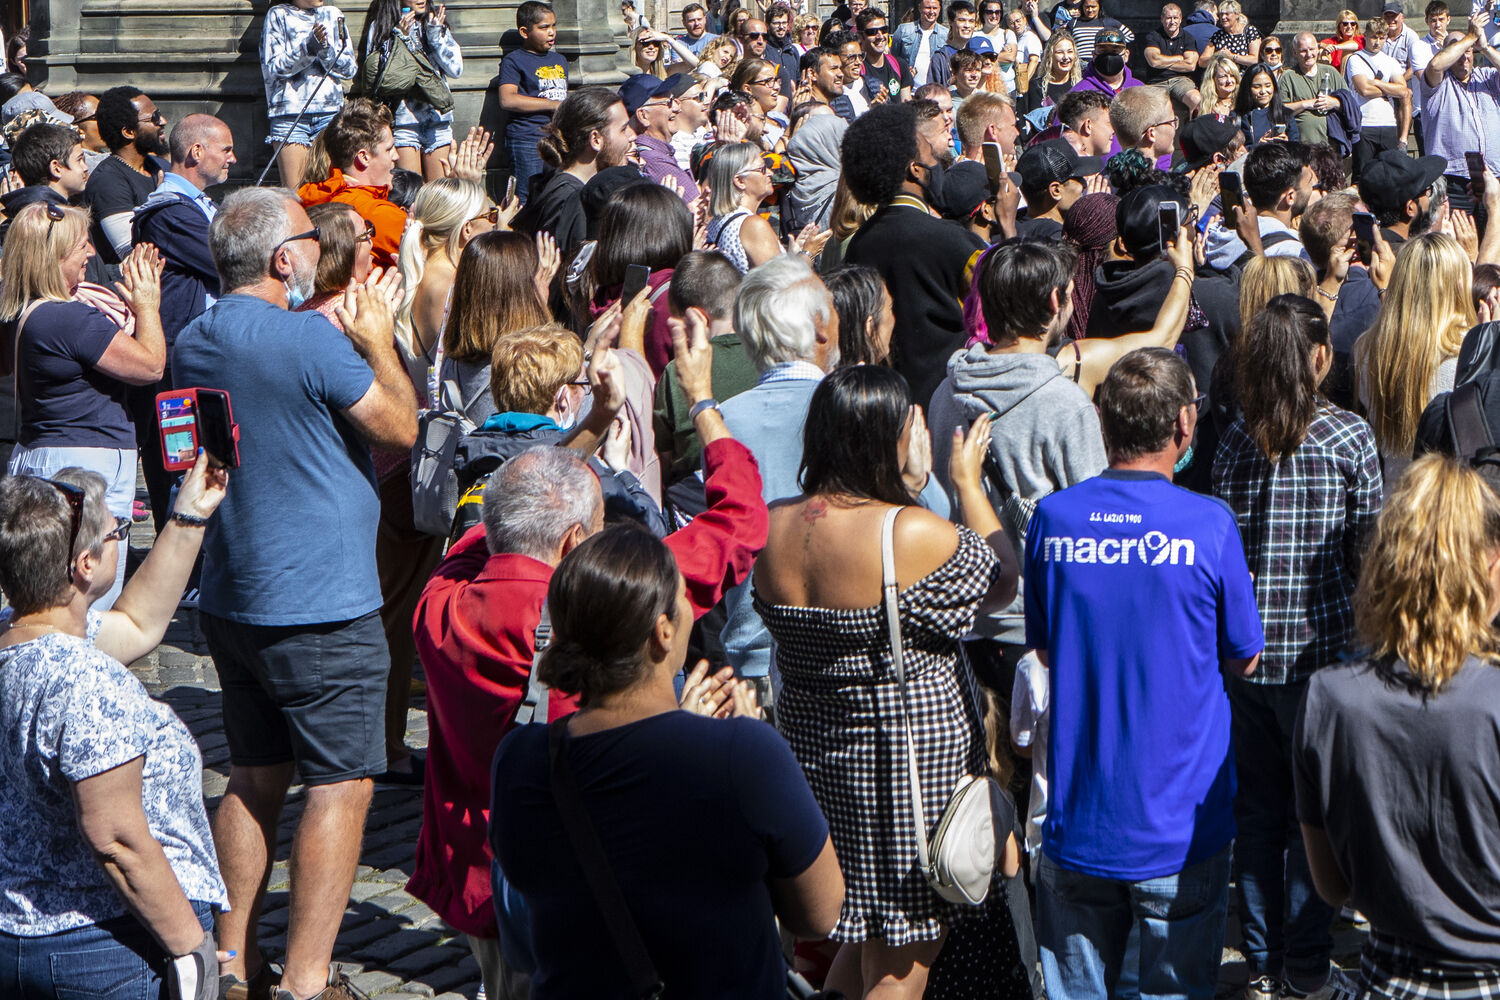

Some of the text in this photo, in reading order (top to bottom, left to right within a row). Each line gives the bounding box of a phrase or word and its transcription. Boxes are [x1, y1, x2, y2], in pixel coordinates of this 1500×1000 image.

[1103, 512, 1124, 524] LAZIO
[1125, 513, 1142, 524] 1900
[1044, 531, 1195, 566] macron
